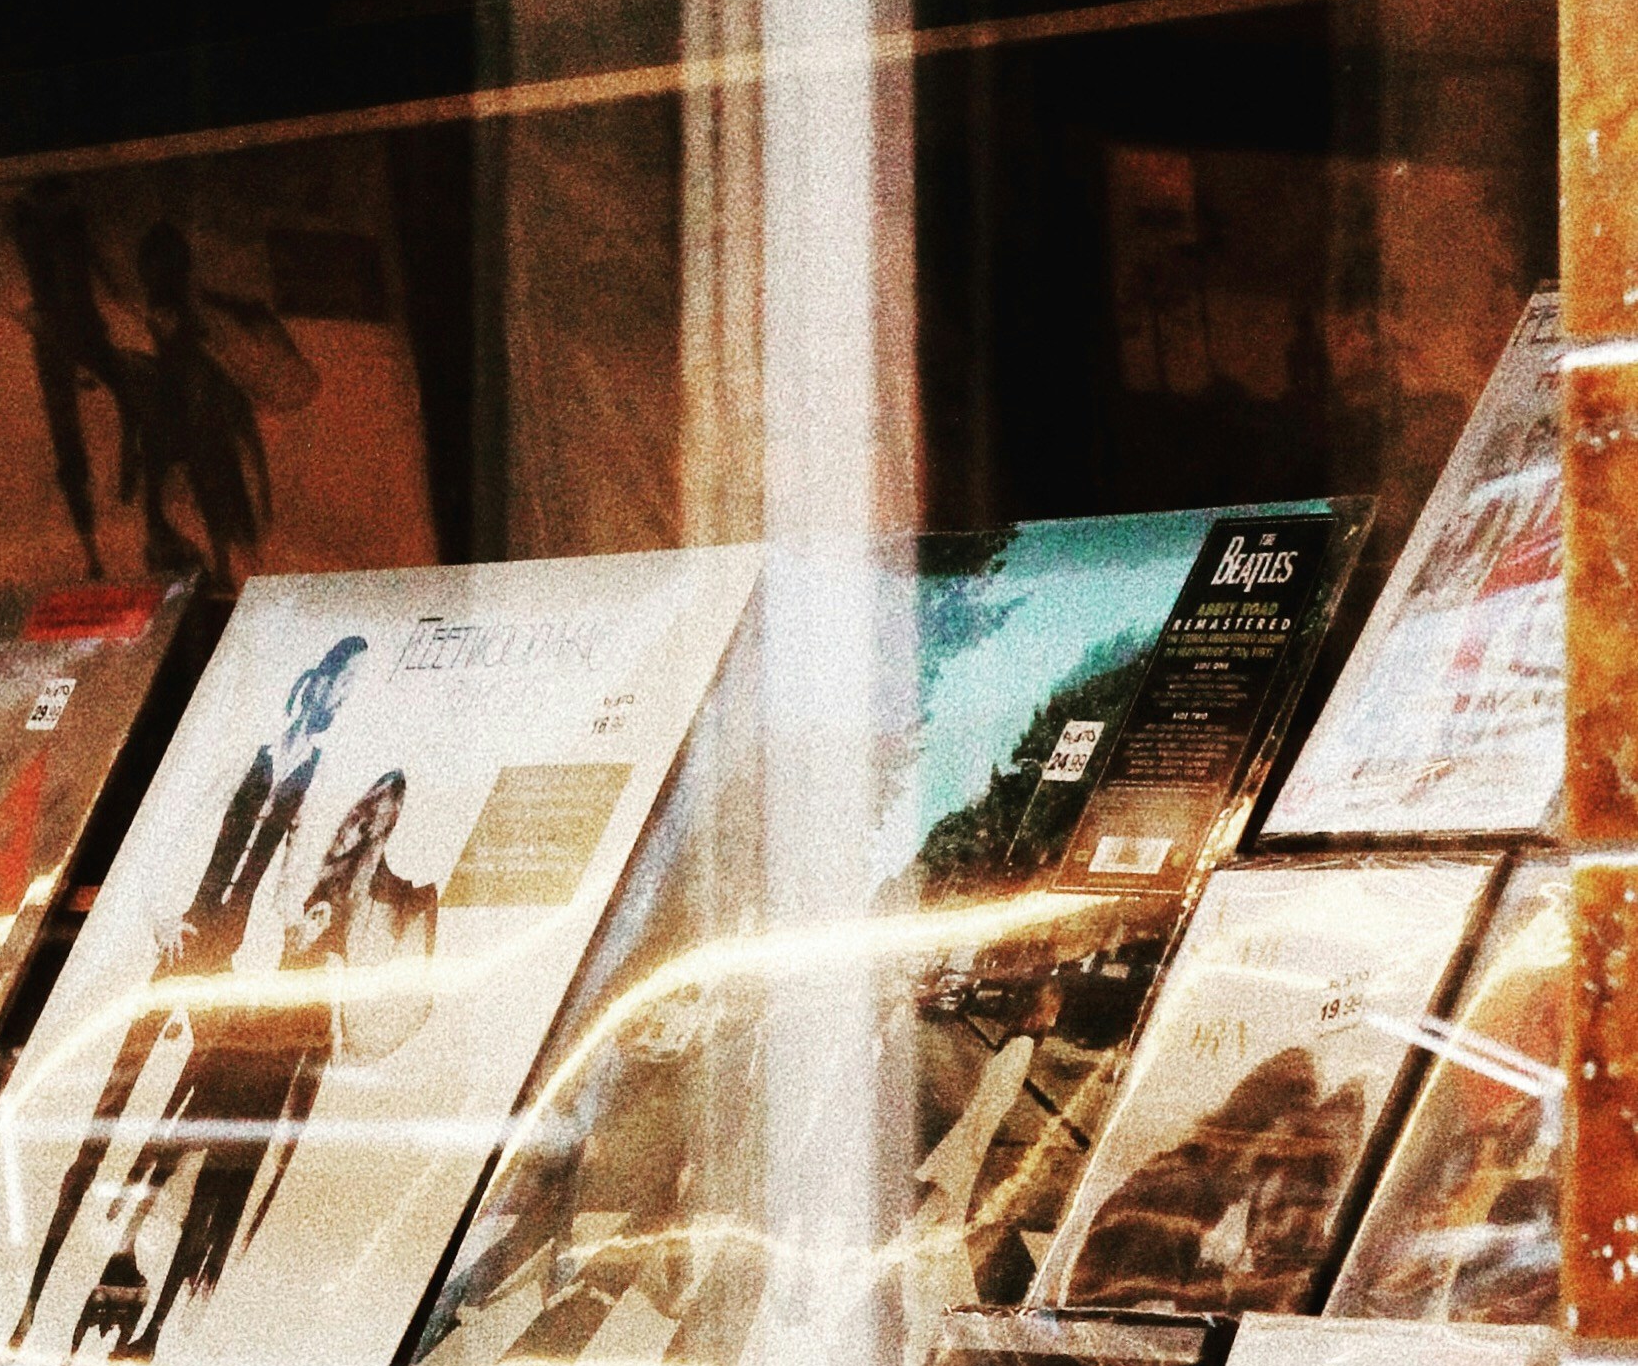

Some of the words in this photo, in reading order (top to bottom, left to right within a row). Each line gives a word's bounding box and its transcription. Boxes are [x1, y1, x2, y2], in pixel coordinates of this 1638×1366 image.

[1210, 535, 1299, 593] BEATLES
[1239, 601, 1280, 616] ROAD
[1171, 617, 1293, 633] REMASTERED
